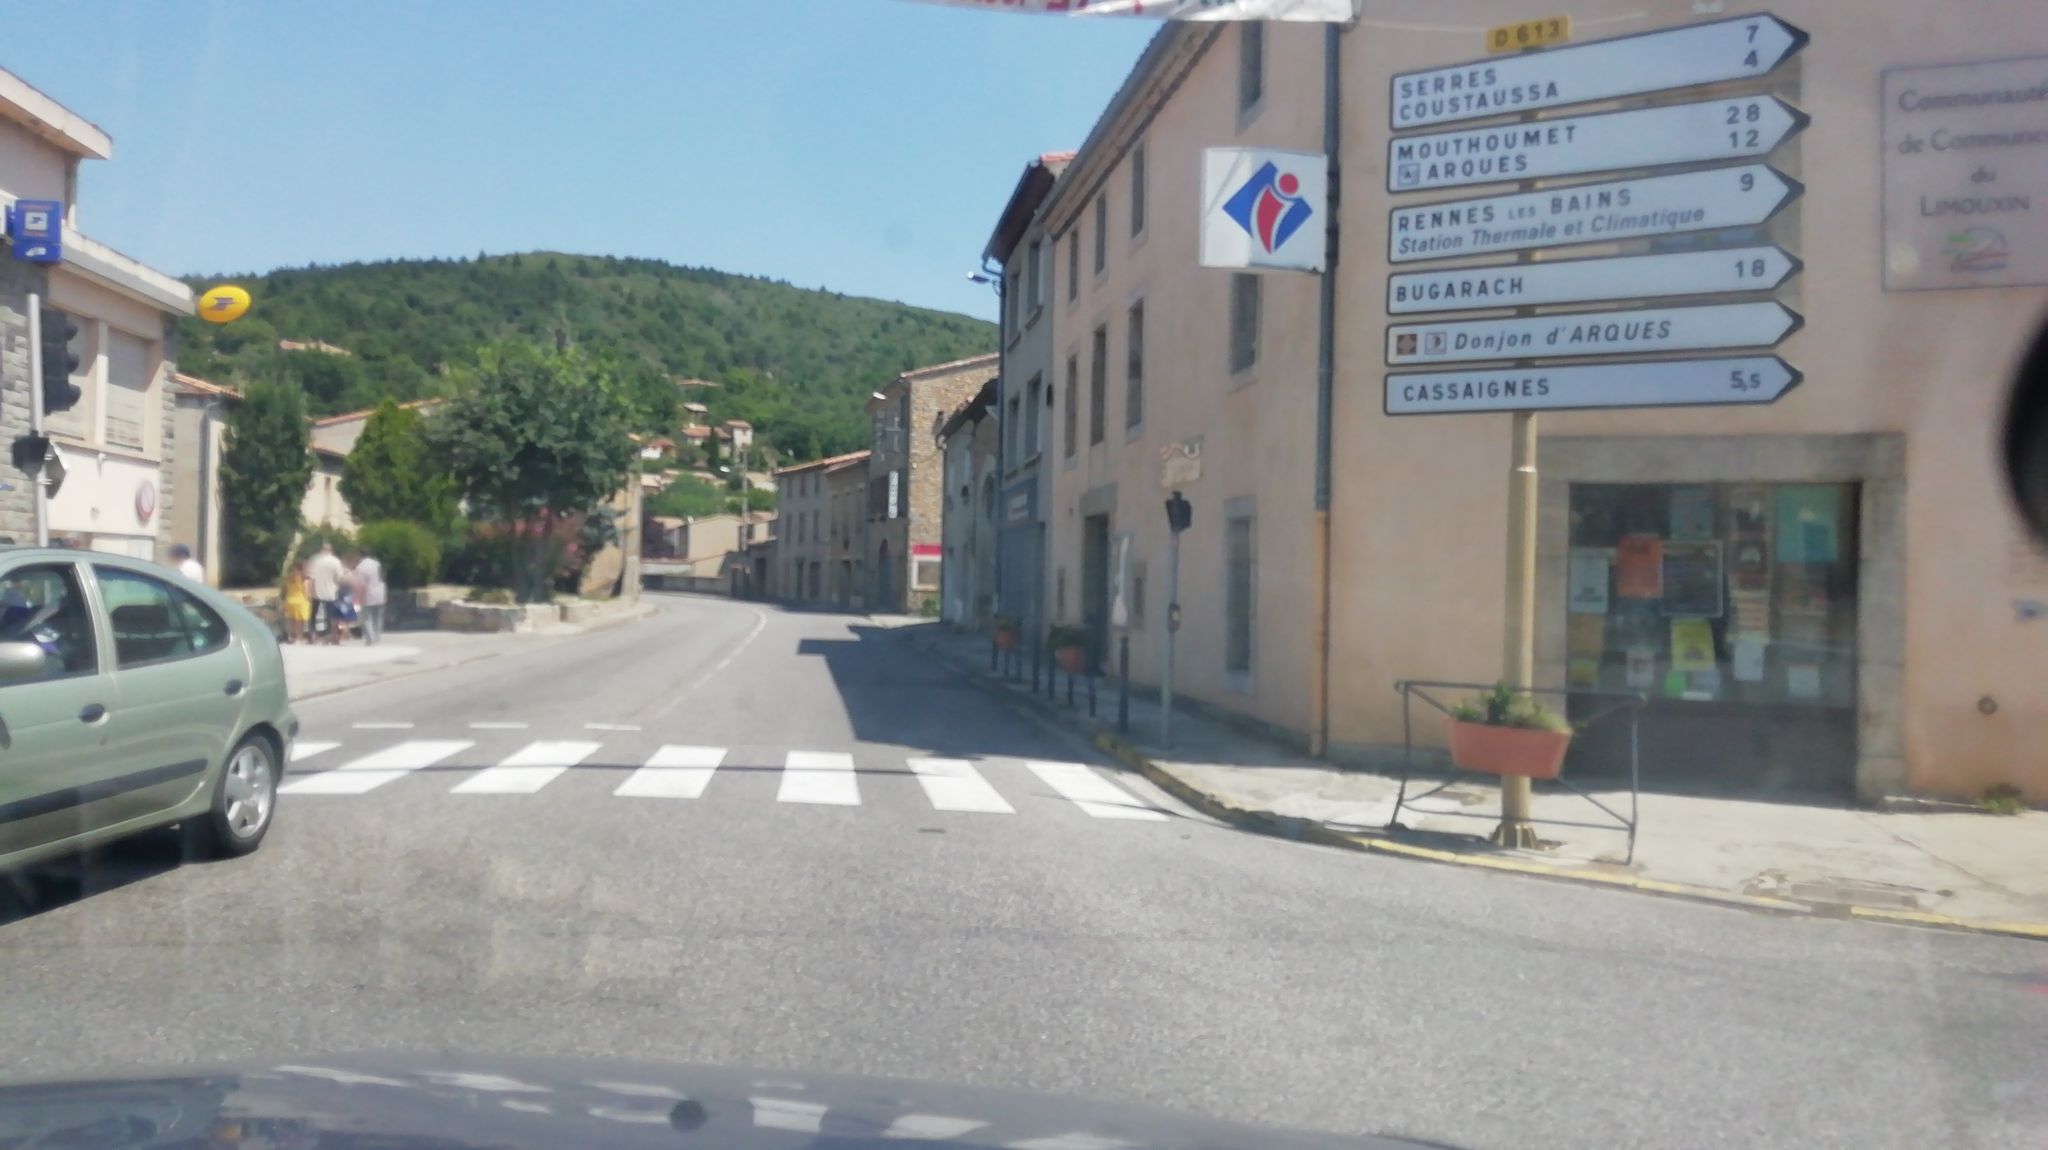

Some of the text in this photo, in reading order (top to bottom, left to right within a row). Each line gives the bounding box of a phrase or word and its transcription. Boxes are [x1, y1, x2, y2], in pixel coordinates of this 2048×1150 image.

[1494, 20, 1559, 48] D 613
[1746, 25, 1758, 43] 7
[1744, 50, 1757, 67] 4
[1401, 68, 1496, 99] SERRES
[1401, 82, 1558, 120] COUSTAUSSA
[1727, 104, 1760, 124] 28
[1398, 125, 1576, 161] MOUTHOUMET
[1729, 129, 1758, 148] 12
[1898, 133, 1924, 154] de
[1427, 154, 1527, 180] ARQUES
[1740, 173, 1754, 191] 9
[1398, 188, 1631, 231] RENNES LES BAINS
[1400, 208, 1705, 254] Station Thermale et Climatique
[1735, 259, 1765, 277] 18
[1397, 277, 1523, 302] BUGARACH
[1455, 320, 1671, 351] Donjon d'ARQUES
[1404, 378, 1550, 402] CASSAIGNES
[1730, 370, 1761, 391] 5,5
